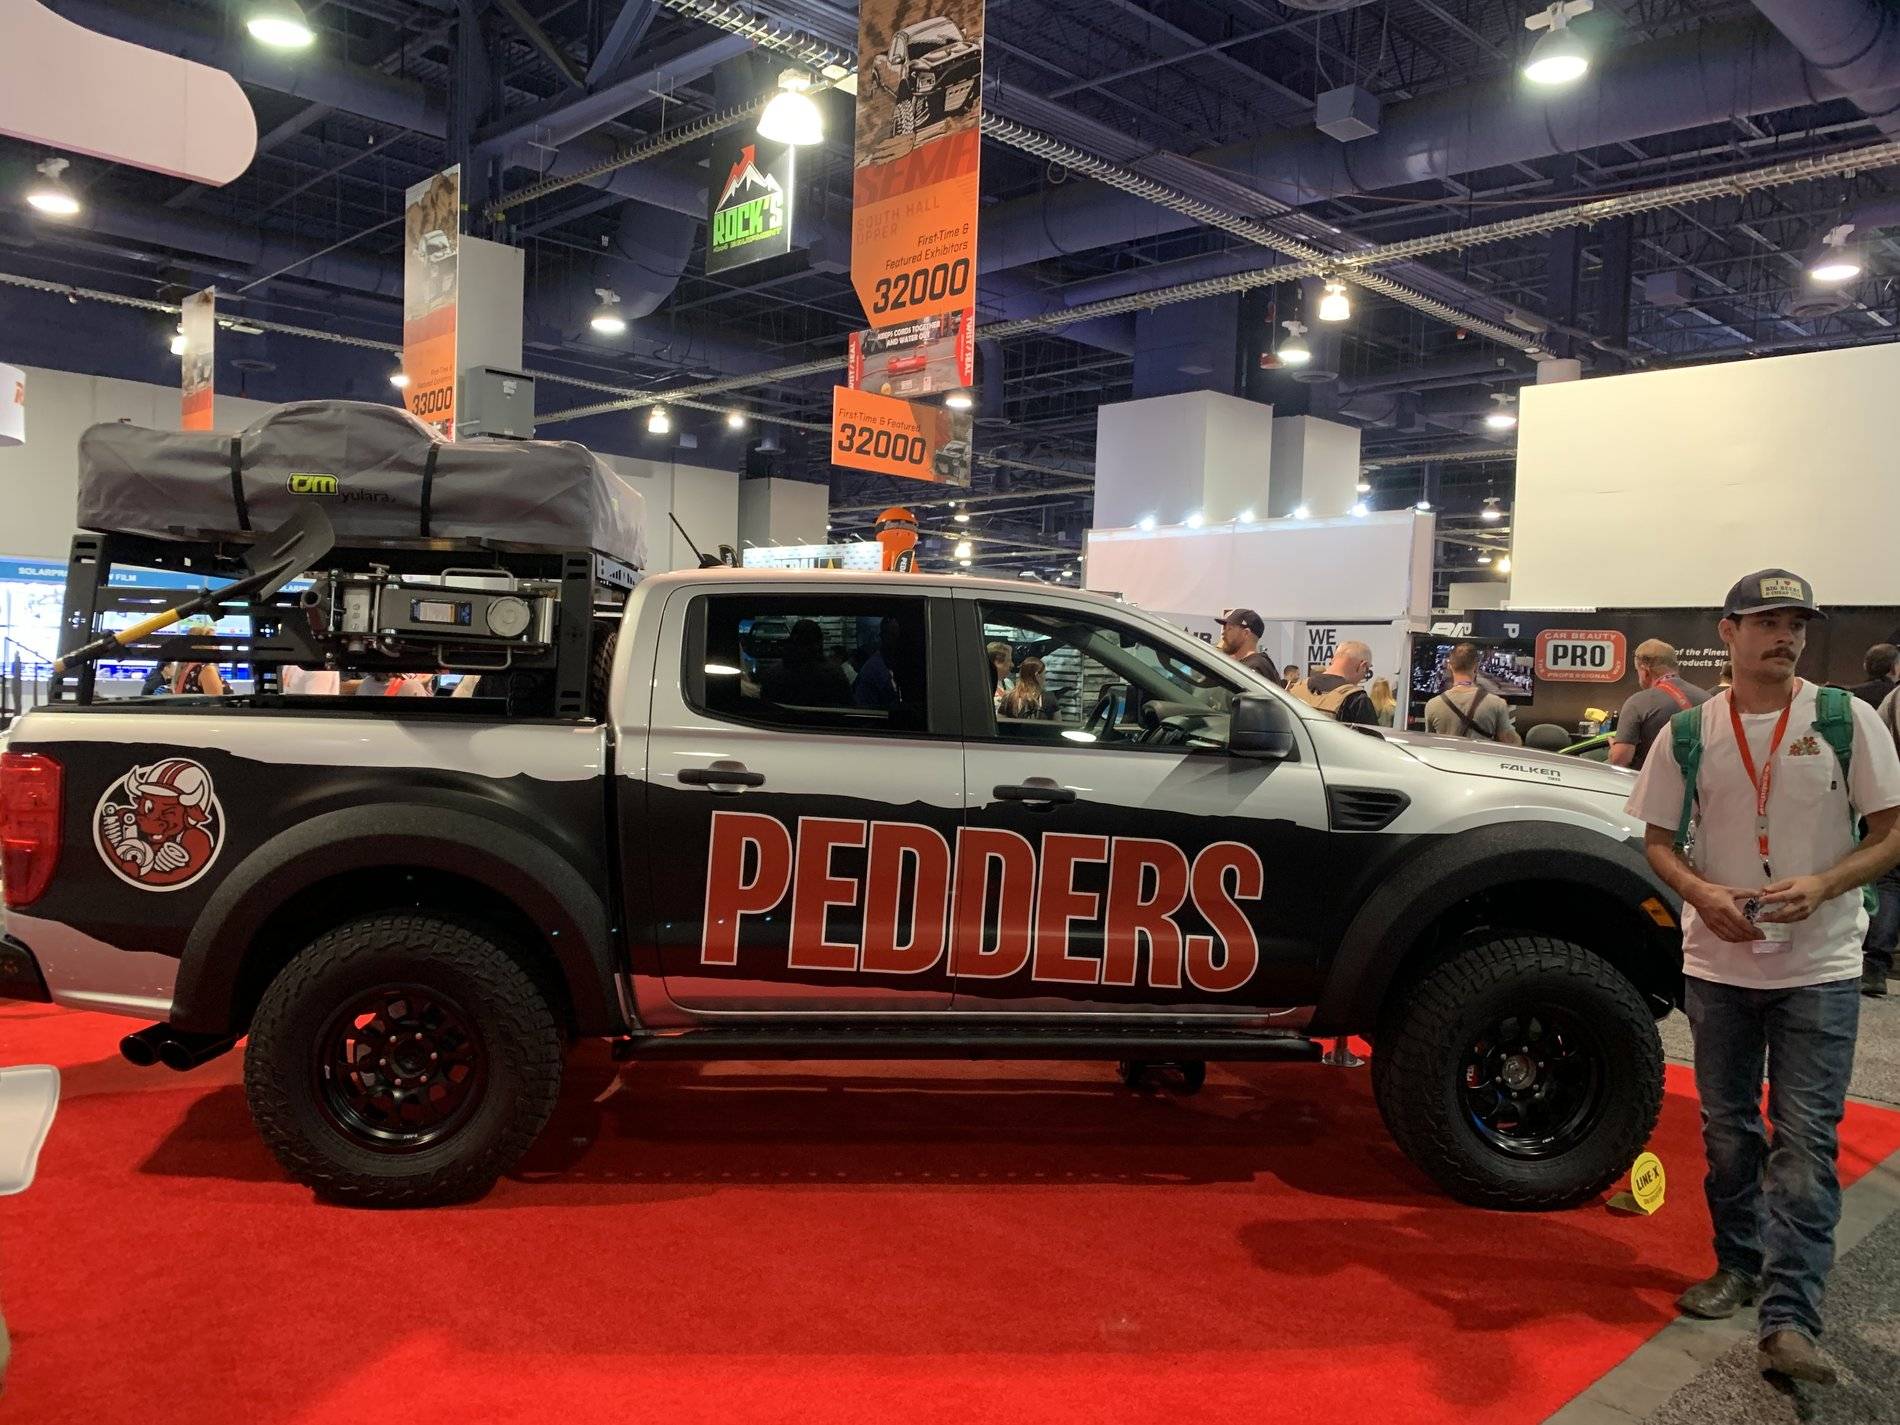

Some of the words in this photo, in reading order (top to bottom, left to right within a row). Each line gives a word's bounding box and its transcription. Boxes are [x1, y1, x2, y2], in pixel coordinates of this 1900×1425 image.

[713, 194, 783, 246] ROCK'S
[856, 209, 900, 230] SOUTH
[906, 196, 941, 216] HALL
[857, 224, 898, 245] UPPER
[917, 226, 960, 247] First-Time
[962, 223, 970, 235] &
[885, 251, 923, 270] Featured
[924, 241, 969, 261] Exhibitors
[873, 257, 971, 314] 32000
[894, 326, 912, 338] CORDS
[912, 320, 941, 334] TOGETHER
[886, 338, 899, 348] AND
[899, 335, 918, 345] WATER
[412, 385, 453, 416] 33000
[879, 417, 886, 426] &
[887, 418, 921, 433] Featured
[837, 422, 927, 465] 32000
[115, 573, 137, 582] FILM
[1308, 629, 1337, 645] WE
[1544, 632, 1568, 640] CAR
[1571, 632, 1617, 640] BEAUTY
[1552, 644, 1606, 668] PRO
[1685, 648, 1701, 656] the
[1678, 659, 1713, 667] roducts
[1547, 672, 1611, 680] PROFESSIONAL
[700, 809, 1264, 993] PEDDERS
